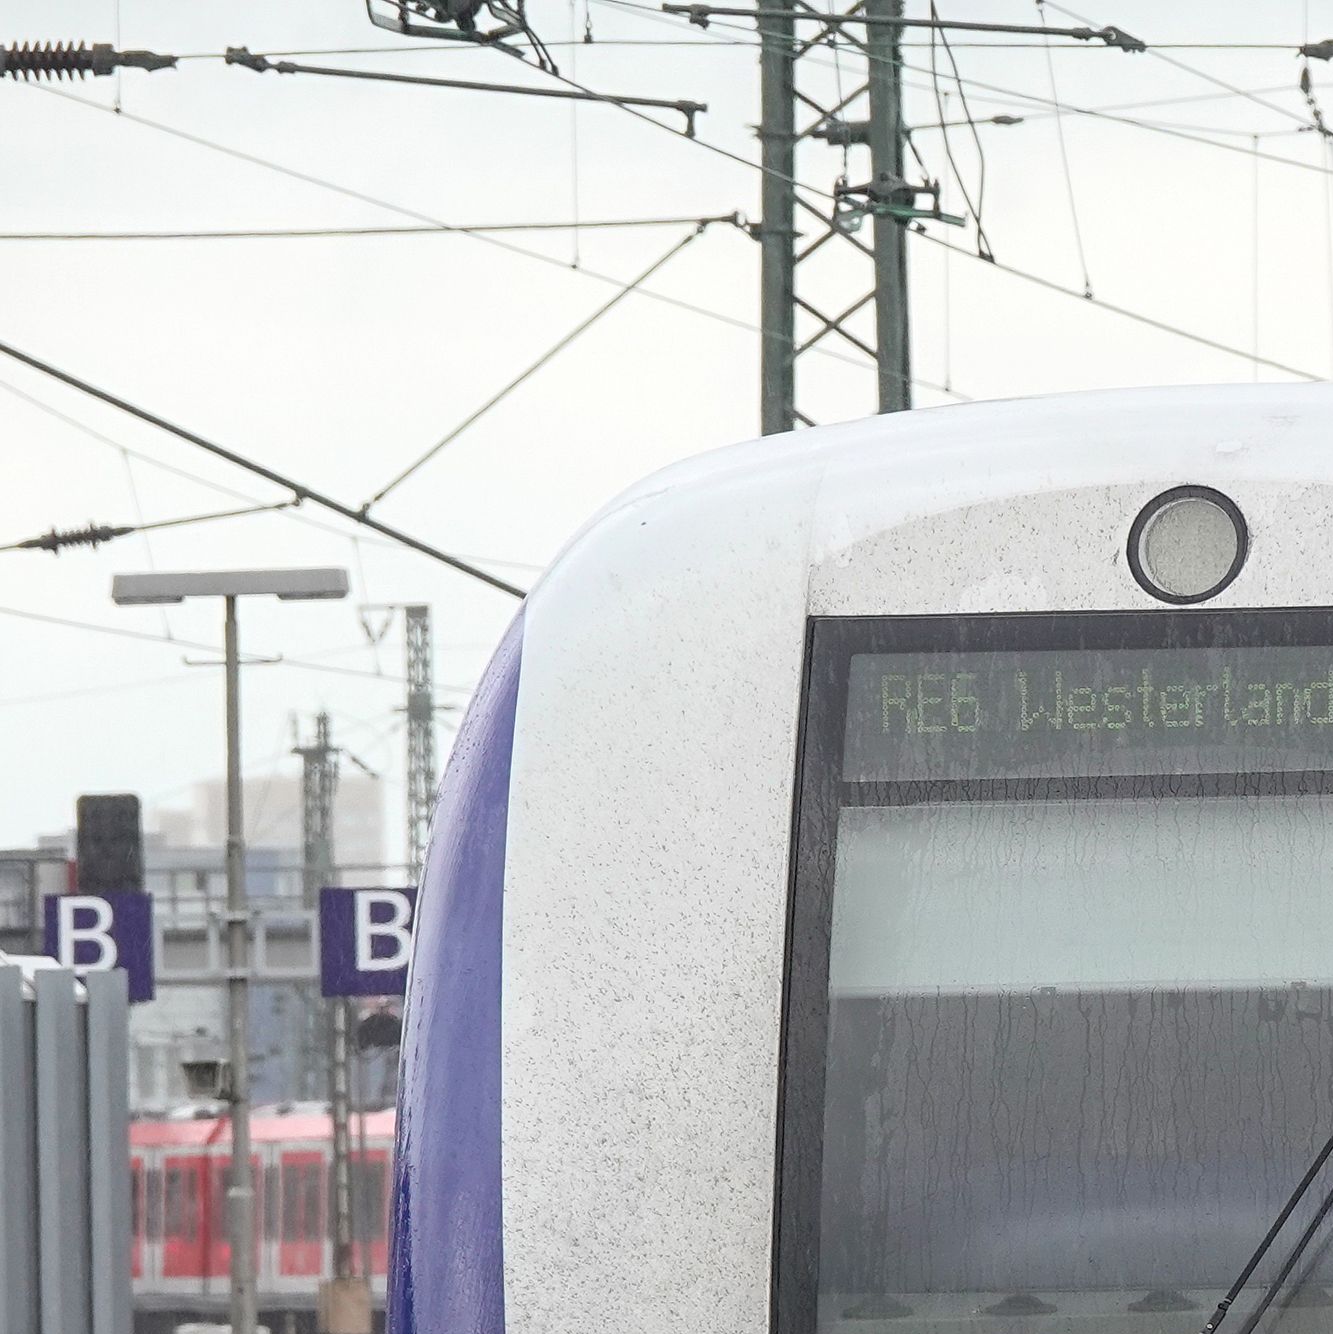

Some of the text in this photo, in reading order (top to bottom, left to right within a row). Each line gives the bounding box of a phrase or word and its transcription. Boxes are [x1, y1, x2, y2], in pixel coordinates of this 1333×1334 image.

[880, 673, 982, 733] RE6
[57, 895, 118, 975] B
[353, 890, 413, 973] B
